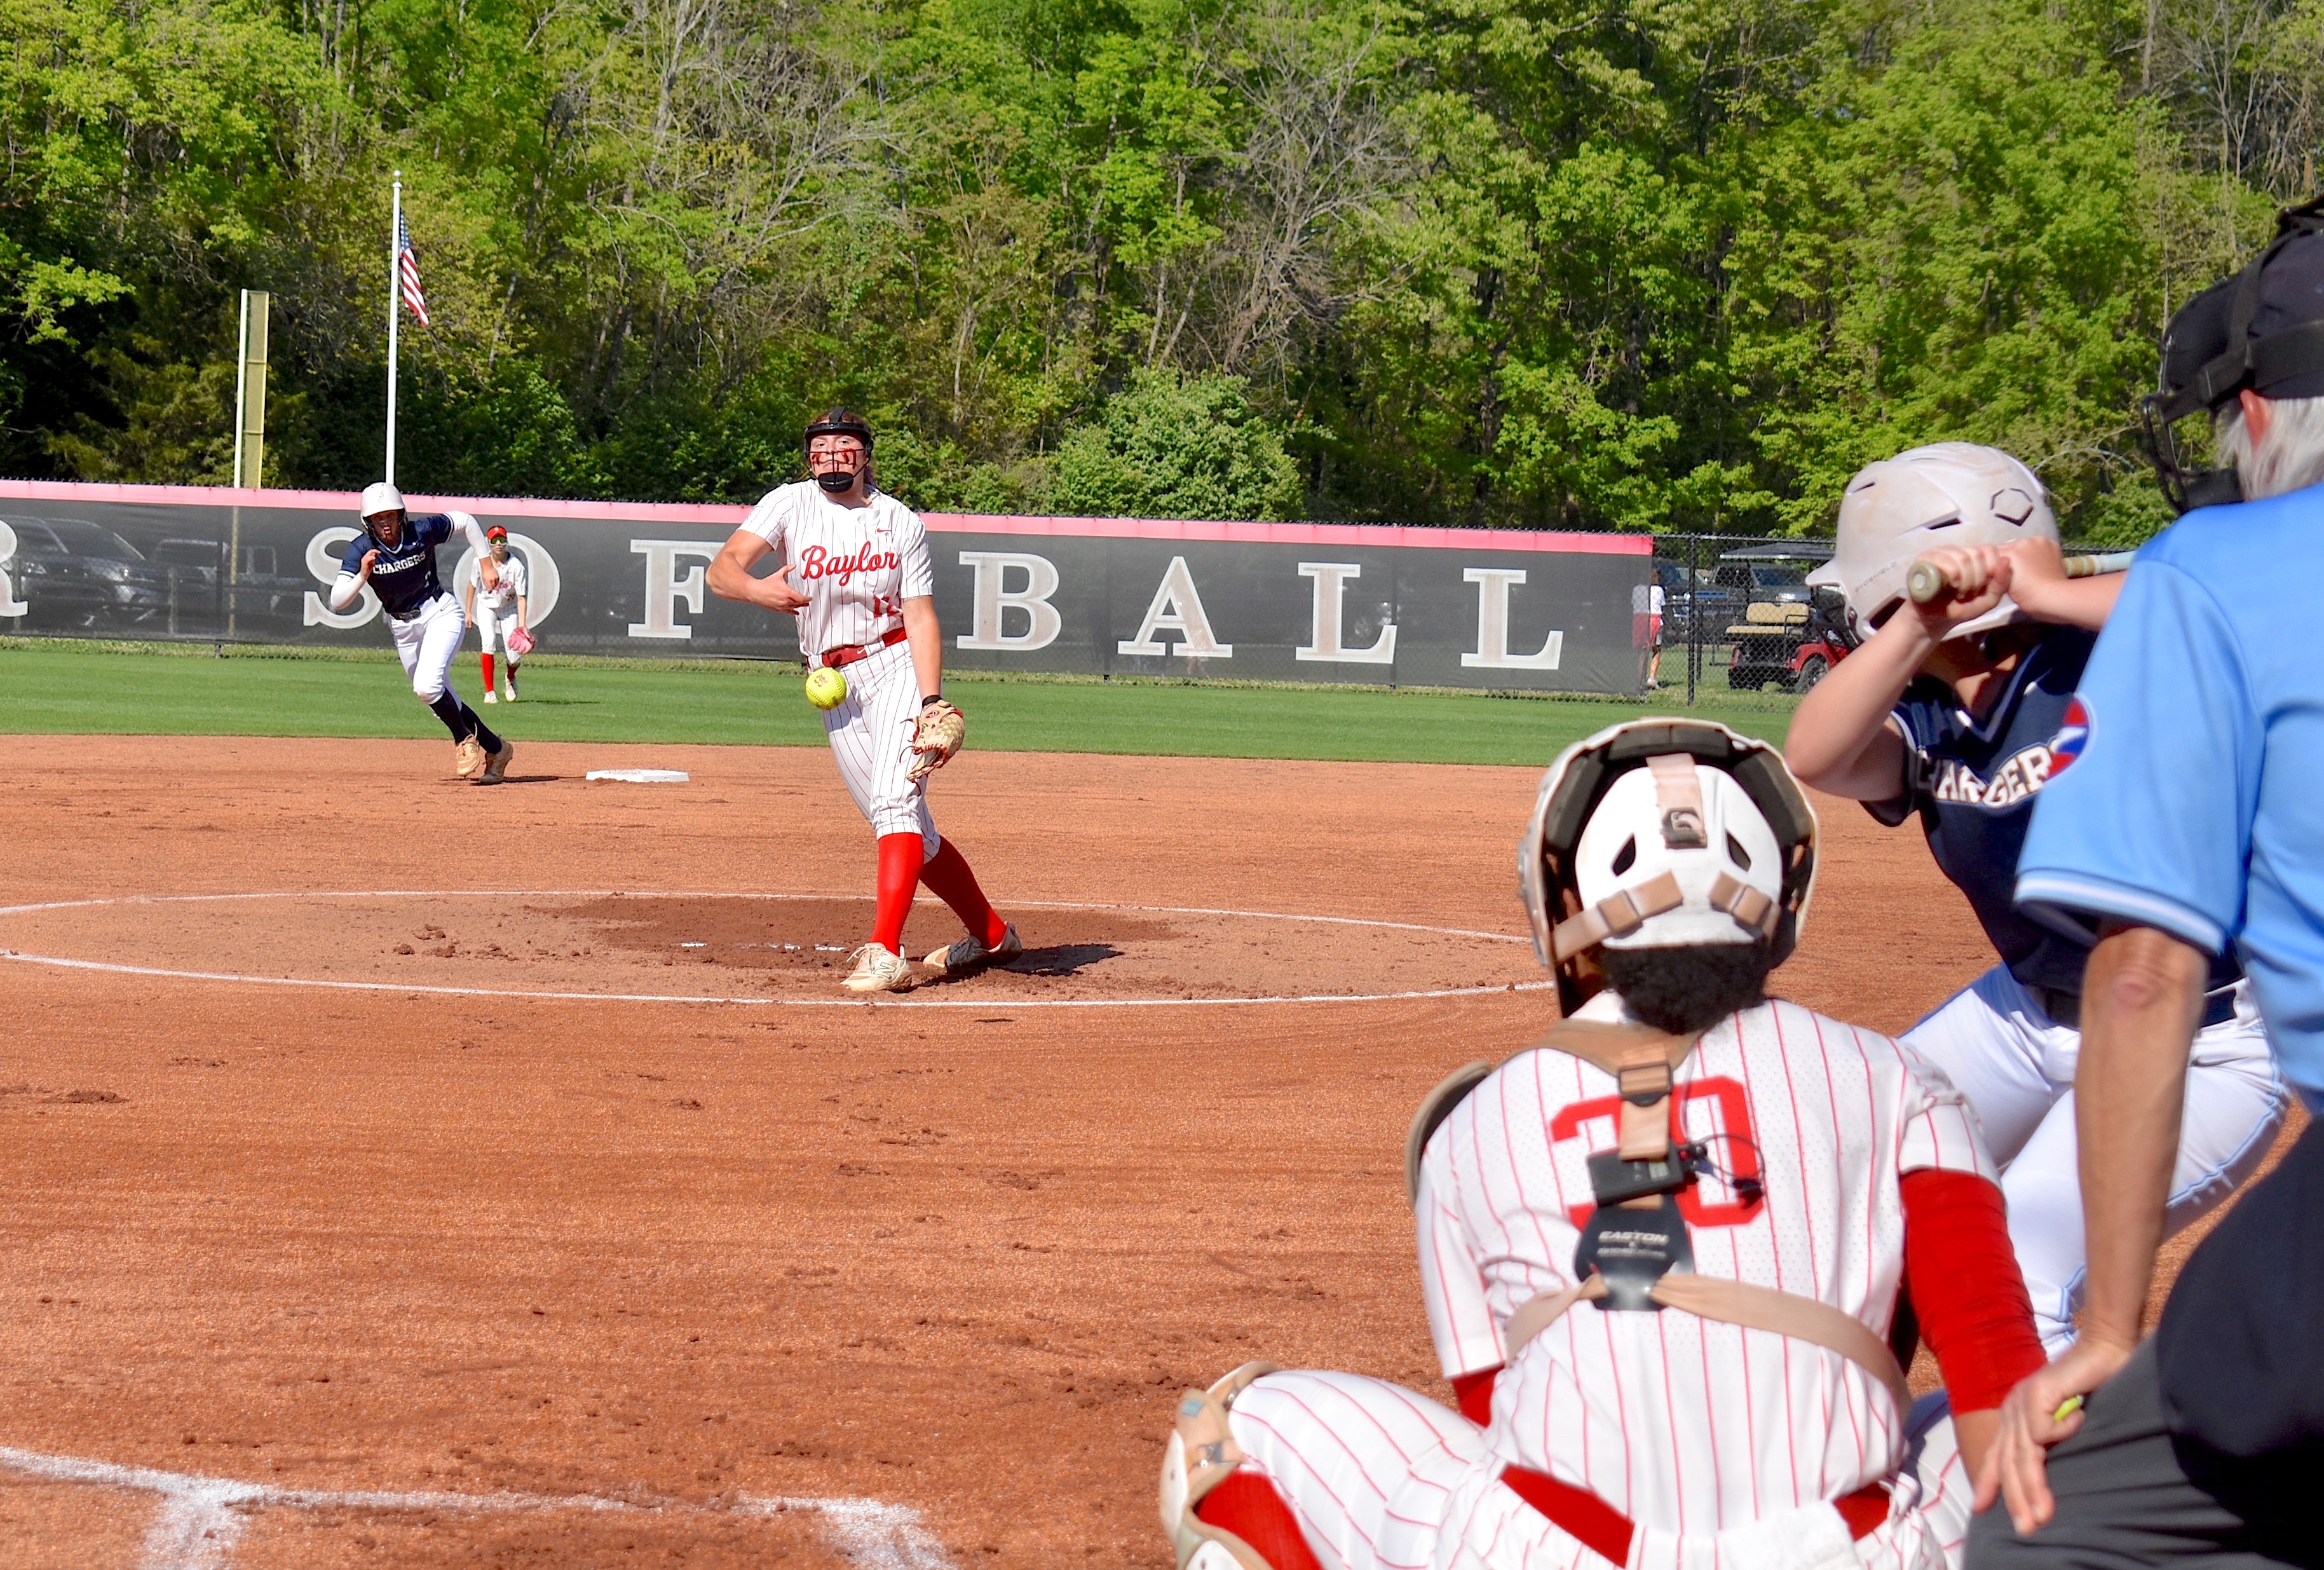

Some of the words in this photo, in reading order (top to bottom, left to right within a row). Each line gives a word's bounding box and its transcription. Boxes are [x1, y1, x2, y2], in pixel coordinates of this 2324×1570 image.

[372, 551, 426, 575] CHARGERS
[801, 540, 899, 587] Baylor
[304, 526, 1563, 671] SOFBALL
[1598, 1231, 1669, 1246] EASTON
